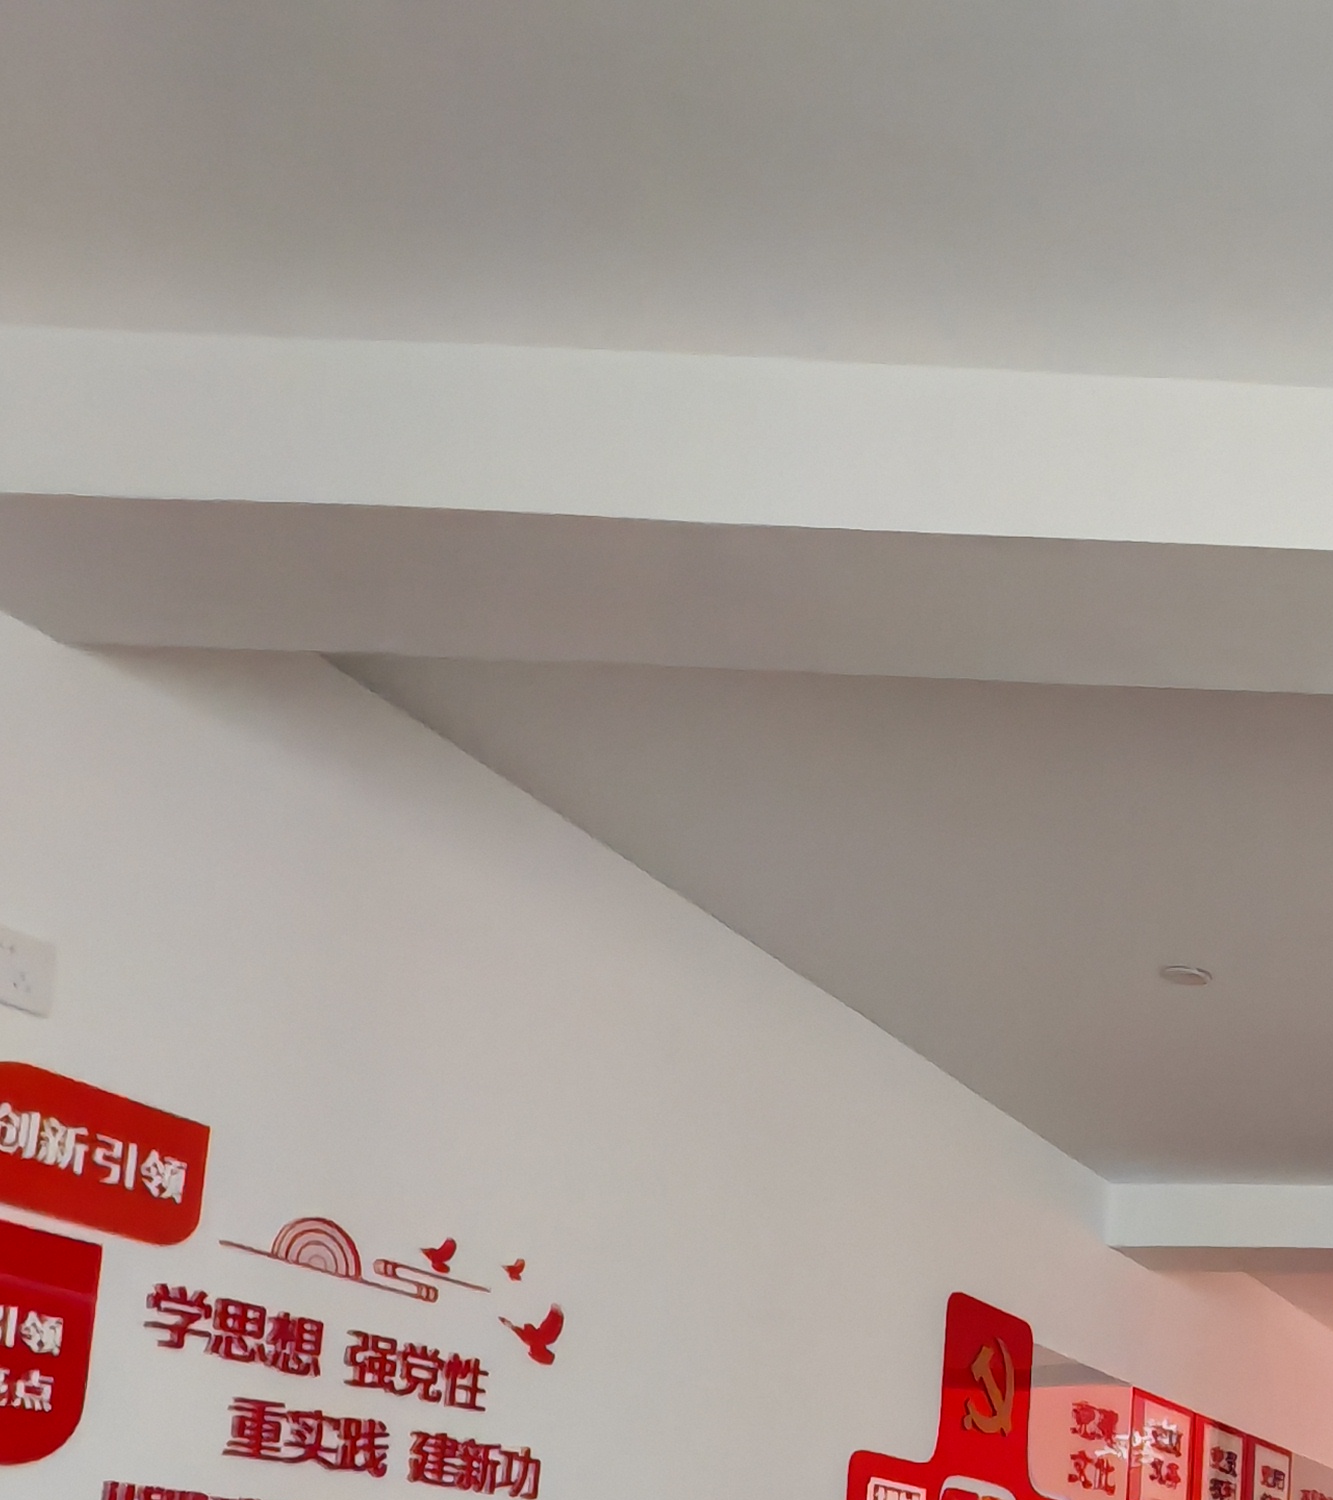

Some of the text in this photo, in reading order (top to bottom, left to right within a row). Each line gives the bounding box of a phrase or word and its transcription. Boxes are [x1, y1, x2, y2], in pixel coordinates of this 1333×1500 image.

[0, 1102, 188, 1204] 创新引领
[143, 1283, 490, 1412] 学思想 强党性
[222, 1396, 542, 1500] 重实践 建新功
